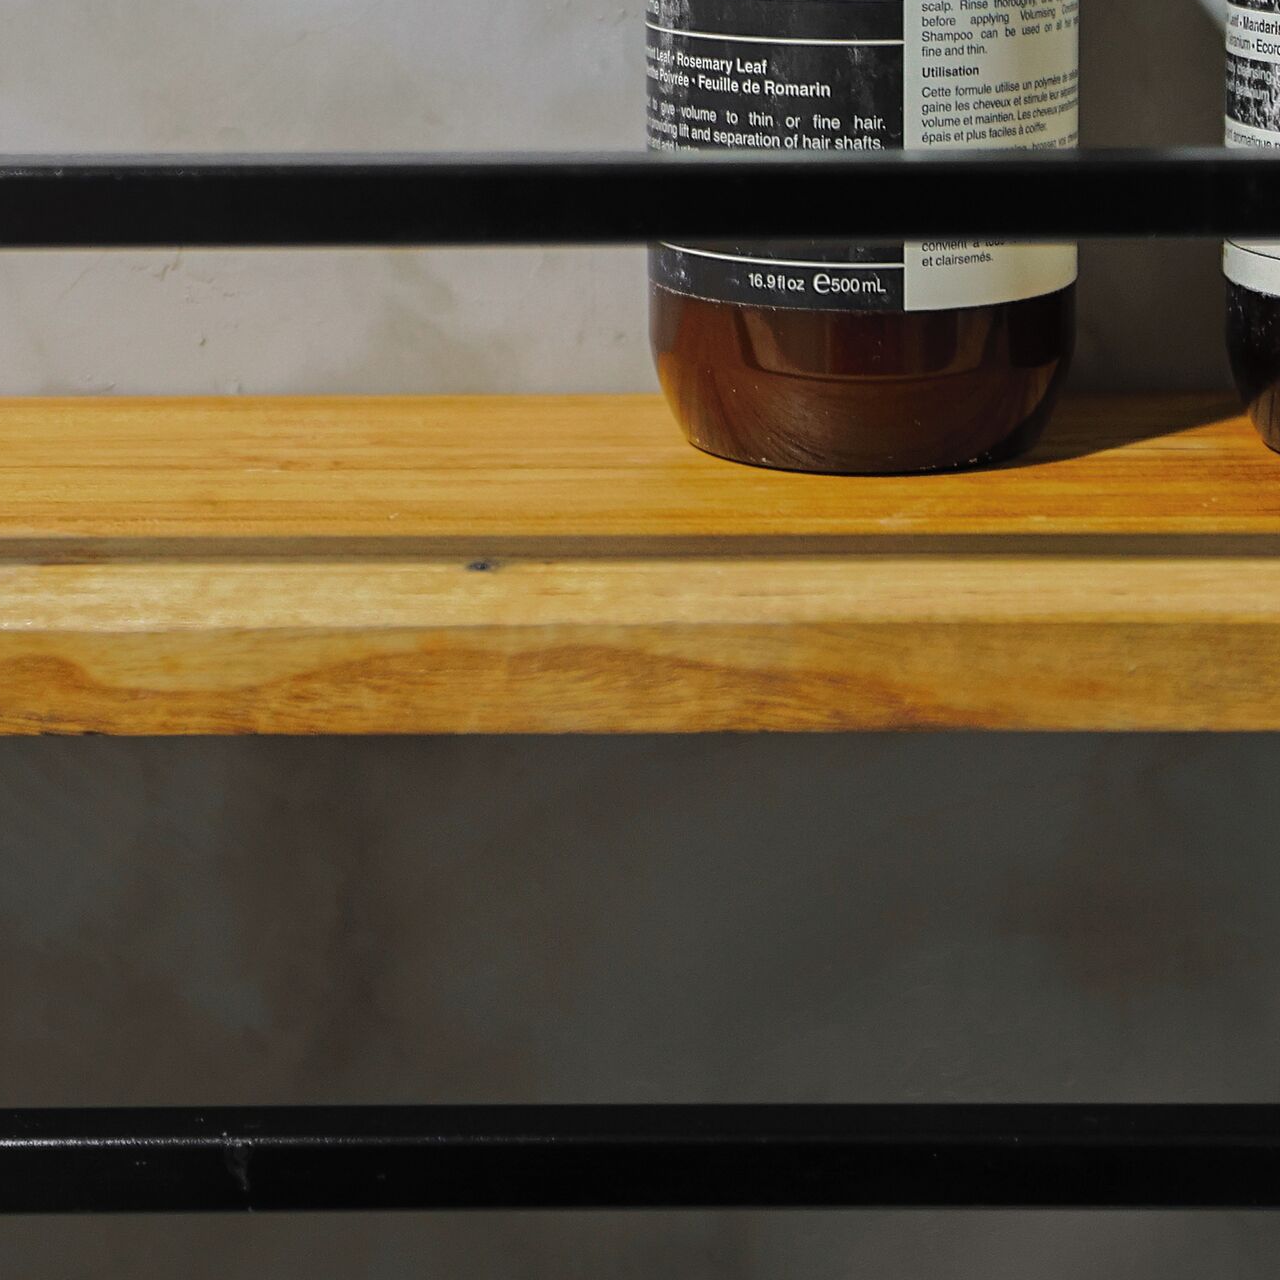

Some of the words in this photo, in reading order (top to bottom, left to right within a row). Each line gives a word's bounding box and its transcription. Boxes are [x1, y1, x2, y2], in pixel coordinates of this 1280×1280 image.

[922, 0, 953, 13] scalp.
[960, 0, 988, 11] Rinse
[922, 16, 956, 27] before
[970, 13, 1010, 26] applying
[1020, 7, 1056, 20] Volumising
[922, 30, 973, 44] Shampoo
[980, 28, 998, 39] can
[1005, 26, 1016, 37] be
[1021, 23, 1040, 35] used
[1044, 22, 1053, 32] on
[922, 46, 942, 57] fine
[944, 44, 965, 56] and
[966, 44, 988, 56] thin.
[676, 52, 733, 75] Rosemary
[737, 58, 768, 75] Leaf
[922, 66, 980, 78] Utilisation
[659, 67, 689, 87] Poivrée
[698, 74, 738, 92] Feuille
[742, 79, 761, 94] de
[764, 80, 831, 98] Romarin
[922, 86, 951, 98] Cette
[955, 84, 992, 97] formule
[995, 82, 1020, 94] utilise
[1022, 80, 1032, 90] un
[922, 101, 952, 115] gaine
[955, 100, 970, 112] les
[973, 97, 1012, 110] cheveux
[1013, 95, 1022, 106] et
[1023, 92, 1048, 105] stimule
[680, 106, 717, 122] volume
[726, 110, 738, 125] to
[749, 111, 773, 127] thin
[785, 115, 800, 128] or
[813, 114, 841, 130] fine
[854, 115, 886, 130] hair.
[922, 116, 961, 128] volume
[963, 115, 973, 125] et
[975, 111, 1016, 124] maintien.
[1018, 109, 1031, 121] Les
[1032, 105, 1058, 118] cheveux
[679, 124, 690, 139] lift
[692, 127, 711, 142] and
[713, 130, 781, 150] separation
[784, 133, 799, 148] of
[802, 135, 831, 150] hair
[835, 134, 886, 151] shafts.
[922, 131, 952, 145] épais
[954, 131, 964, 141] et
[966, 129, 987, 143] plus
[989, 126, 1017, 138] faciles
[922, 256, 933, 267] et
[936, 251, 995, 266] clairsemés.
